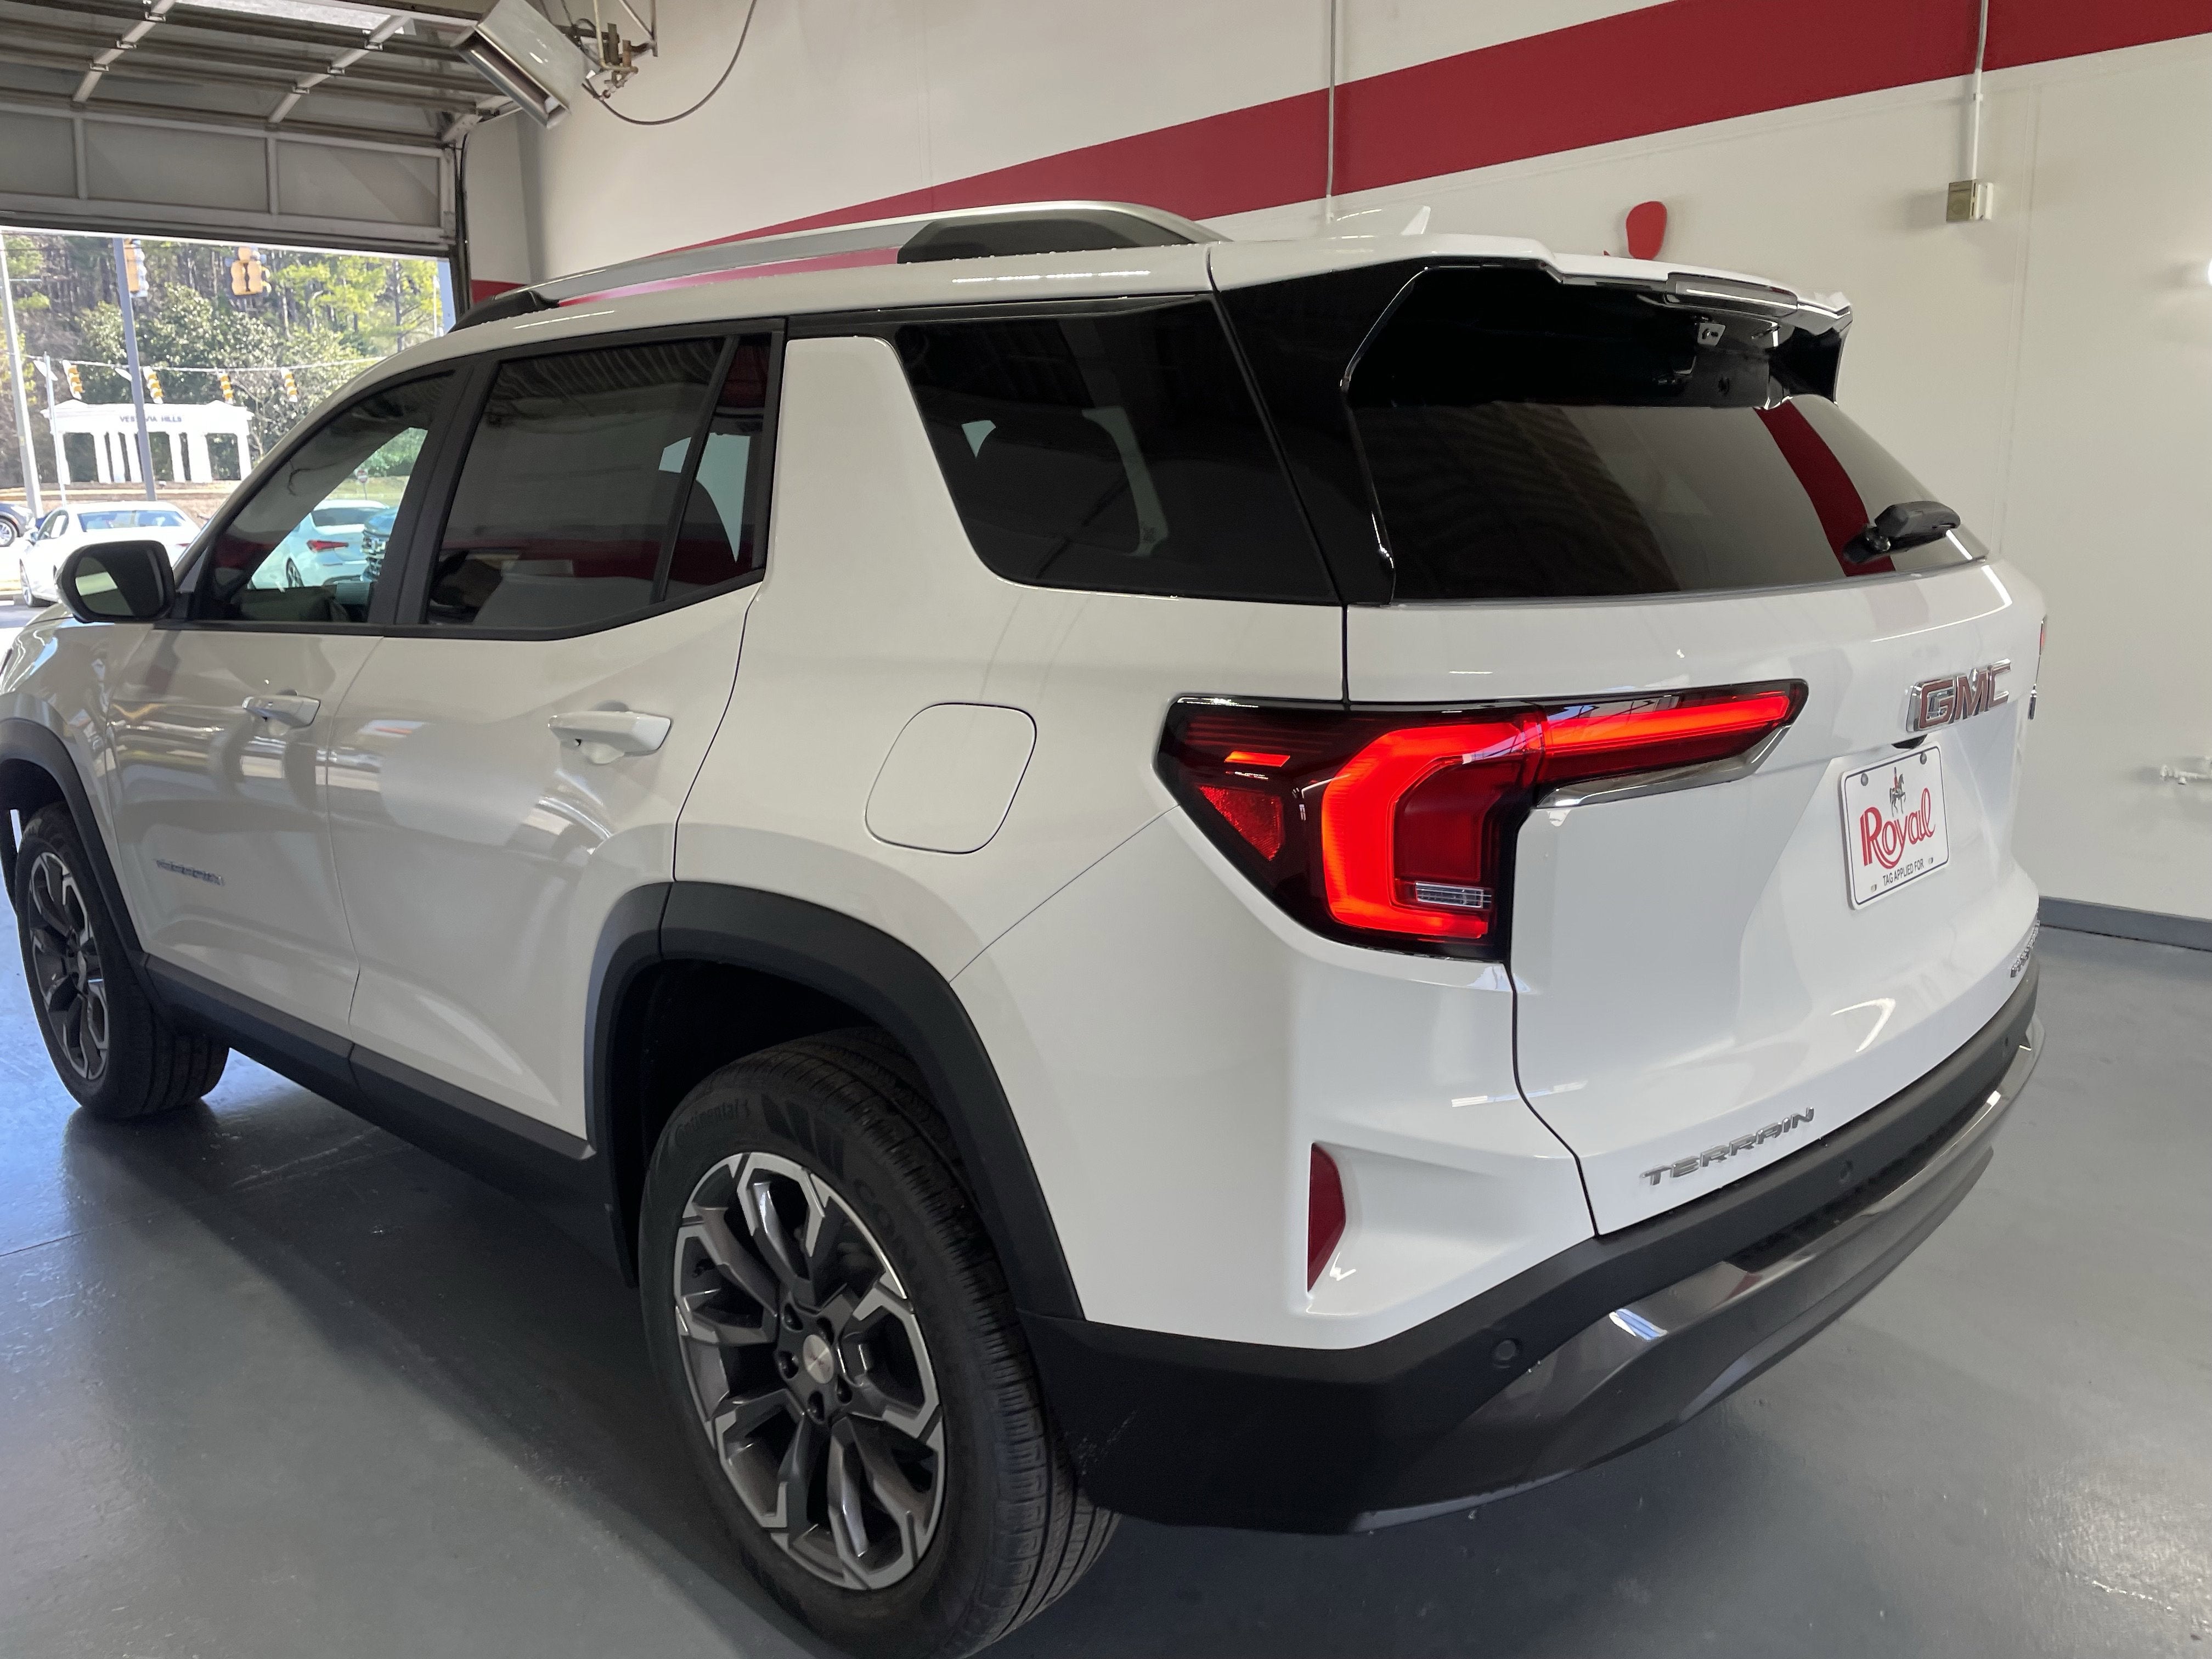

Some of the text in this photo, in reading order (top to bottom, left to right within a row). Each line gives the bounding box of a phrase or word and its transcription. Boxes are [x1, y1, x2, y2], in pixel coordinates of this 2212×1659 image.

[1906, 658, 2011, 732] GMC
[1860, 787, 1936, 869] Royal
[1883, 858, 1925, 886] TAG APPLIED FOR
[1639, 1106, 1815, 1186] TERRAIN
